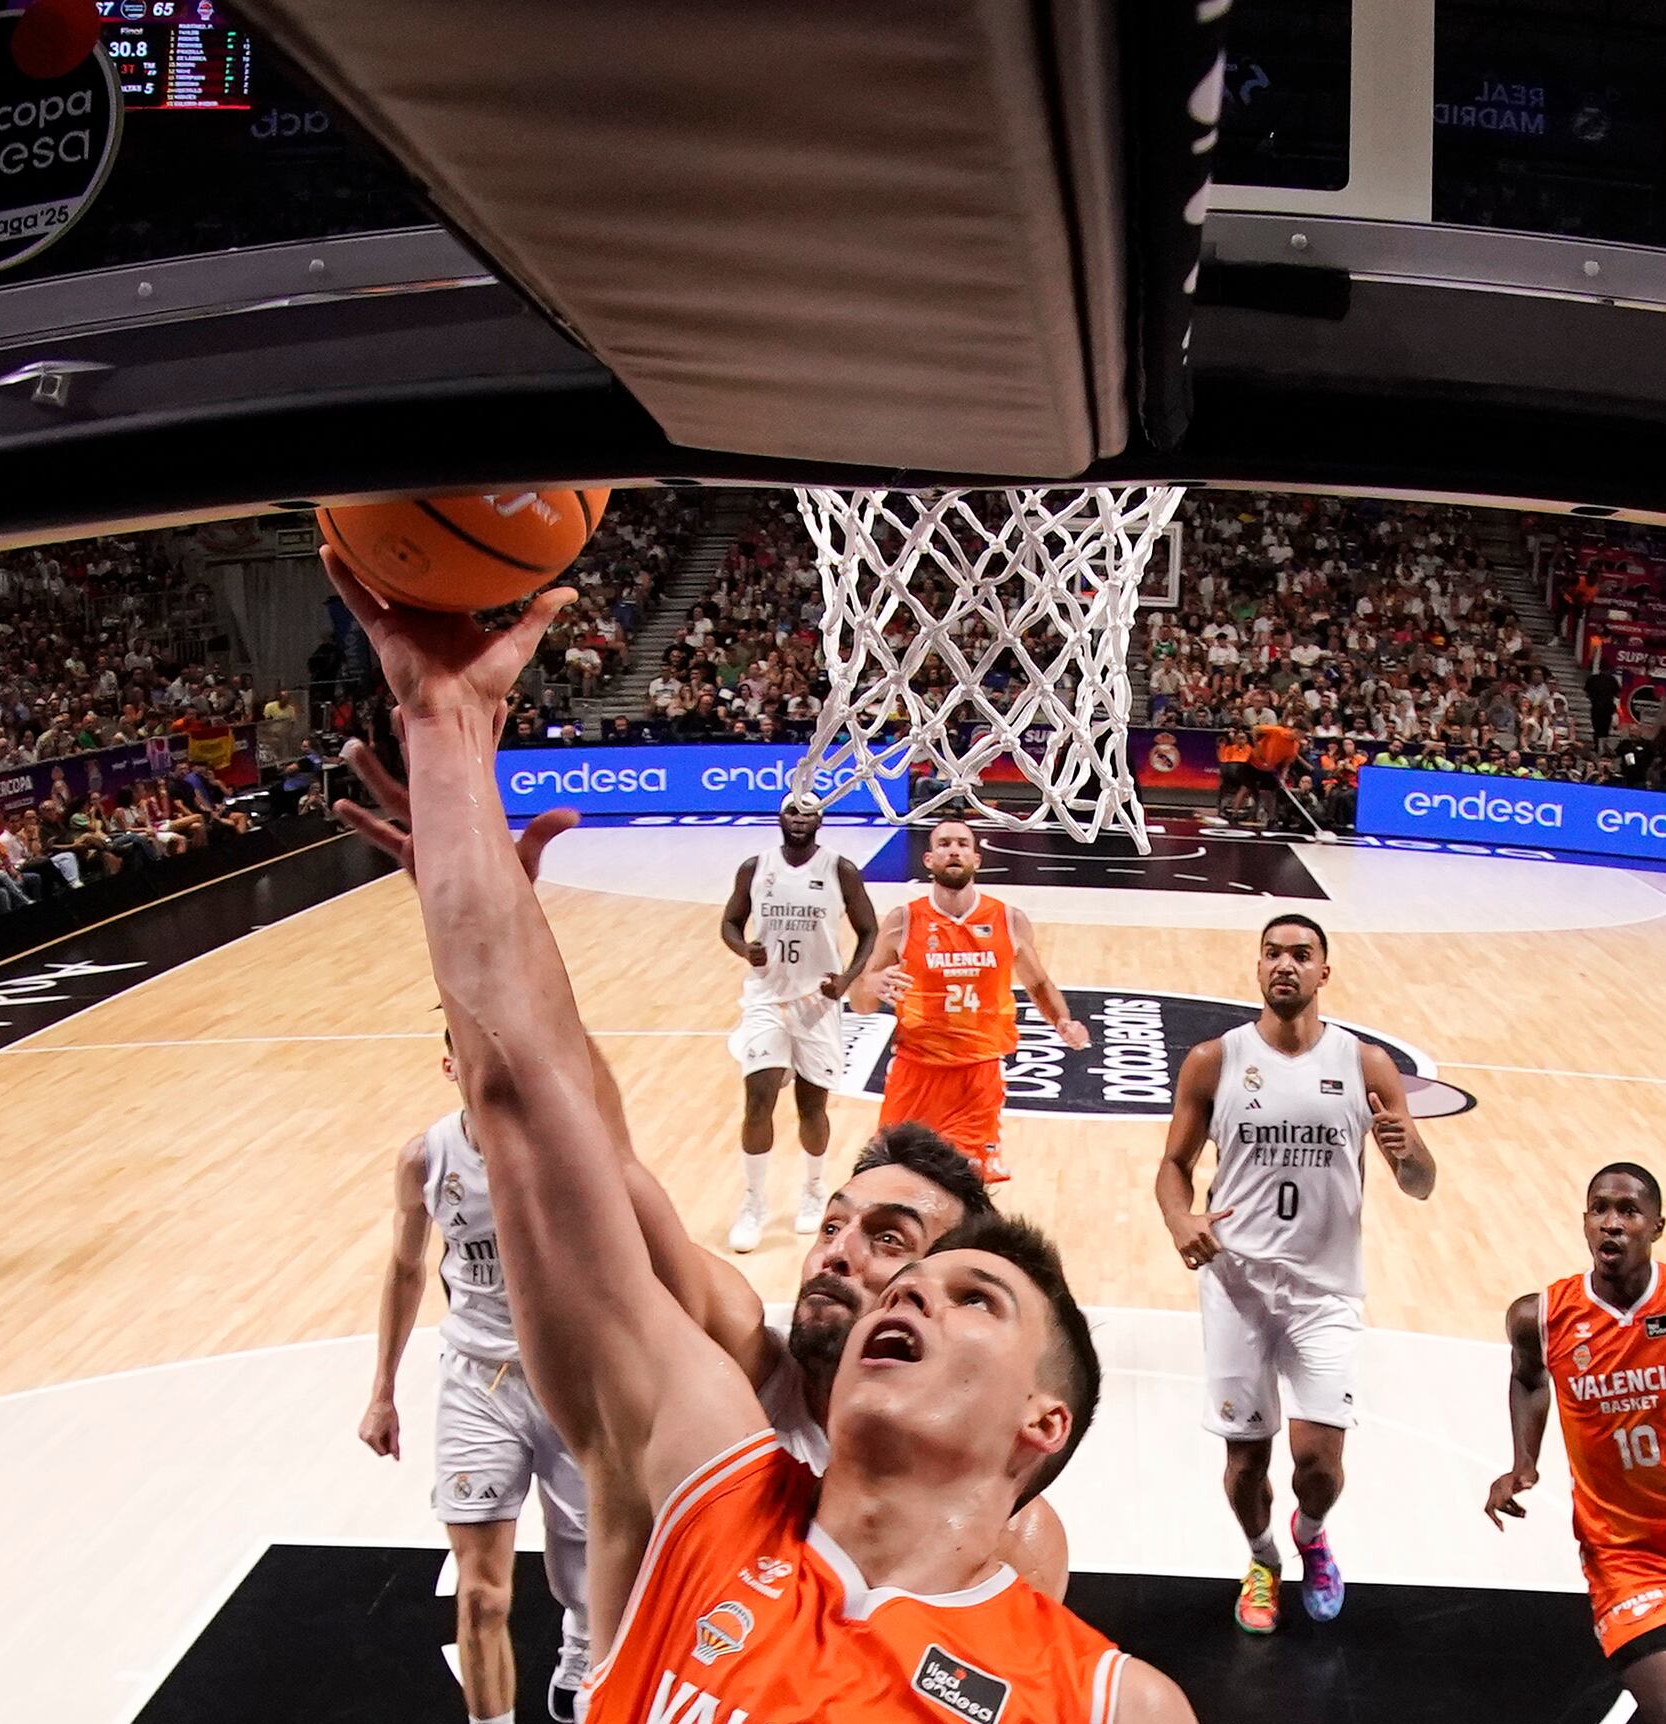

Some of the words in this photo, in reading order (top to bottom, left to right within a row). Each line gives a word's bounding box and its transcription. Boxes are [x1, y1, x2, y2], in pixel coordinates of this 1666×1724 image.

[153, 2, 174, 16] 65
[108, 41, 148, 57] 30.8
[144, 83, 154, 94] 5
[510, 763, 667, 795] endesa
[1404, 790, 1562, 828] endesa
[760, 902, 827, 919] Emirates
[777, 939, 801, 964] 16
[925, 950, 998, 968] VALENCIA
[944, 984, 981, 1013] 24
[1088, 999, 1172, 1103] supercopa
[1239, 1120, 1347, 1147] Emirates
[1254, 1148, 1277, 1167] FLY
[1283, 1149, 1333, 1168] BETTER
[1278, 1181, 1299, 1221] 0
[472, 1265, 494, 1285] FLY
[1600, 1395, 1660, 1414] BASKET
[1613, 1424, 1662, 1471] 10
[927, 1662, 960, 1689] liga
